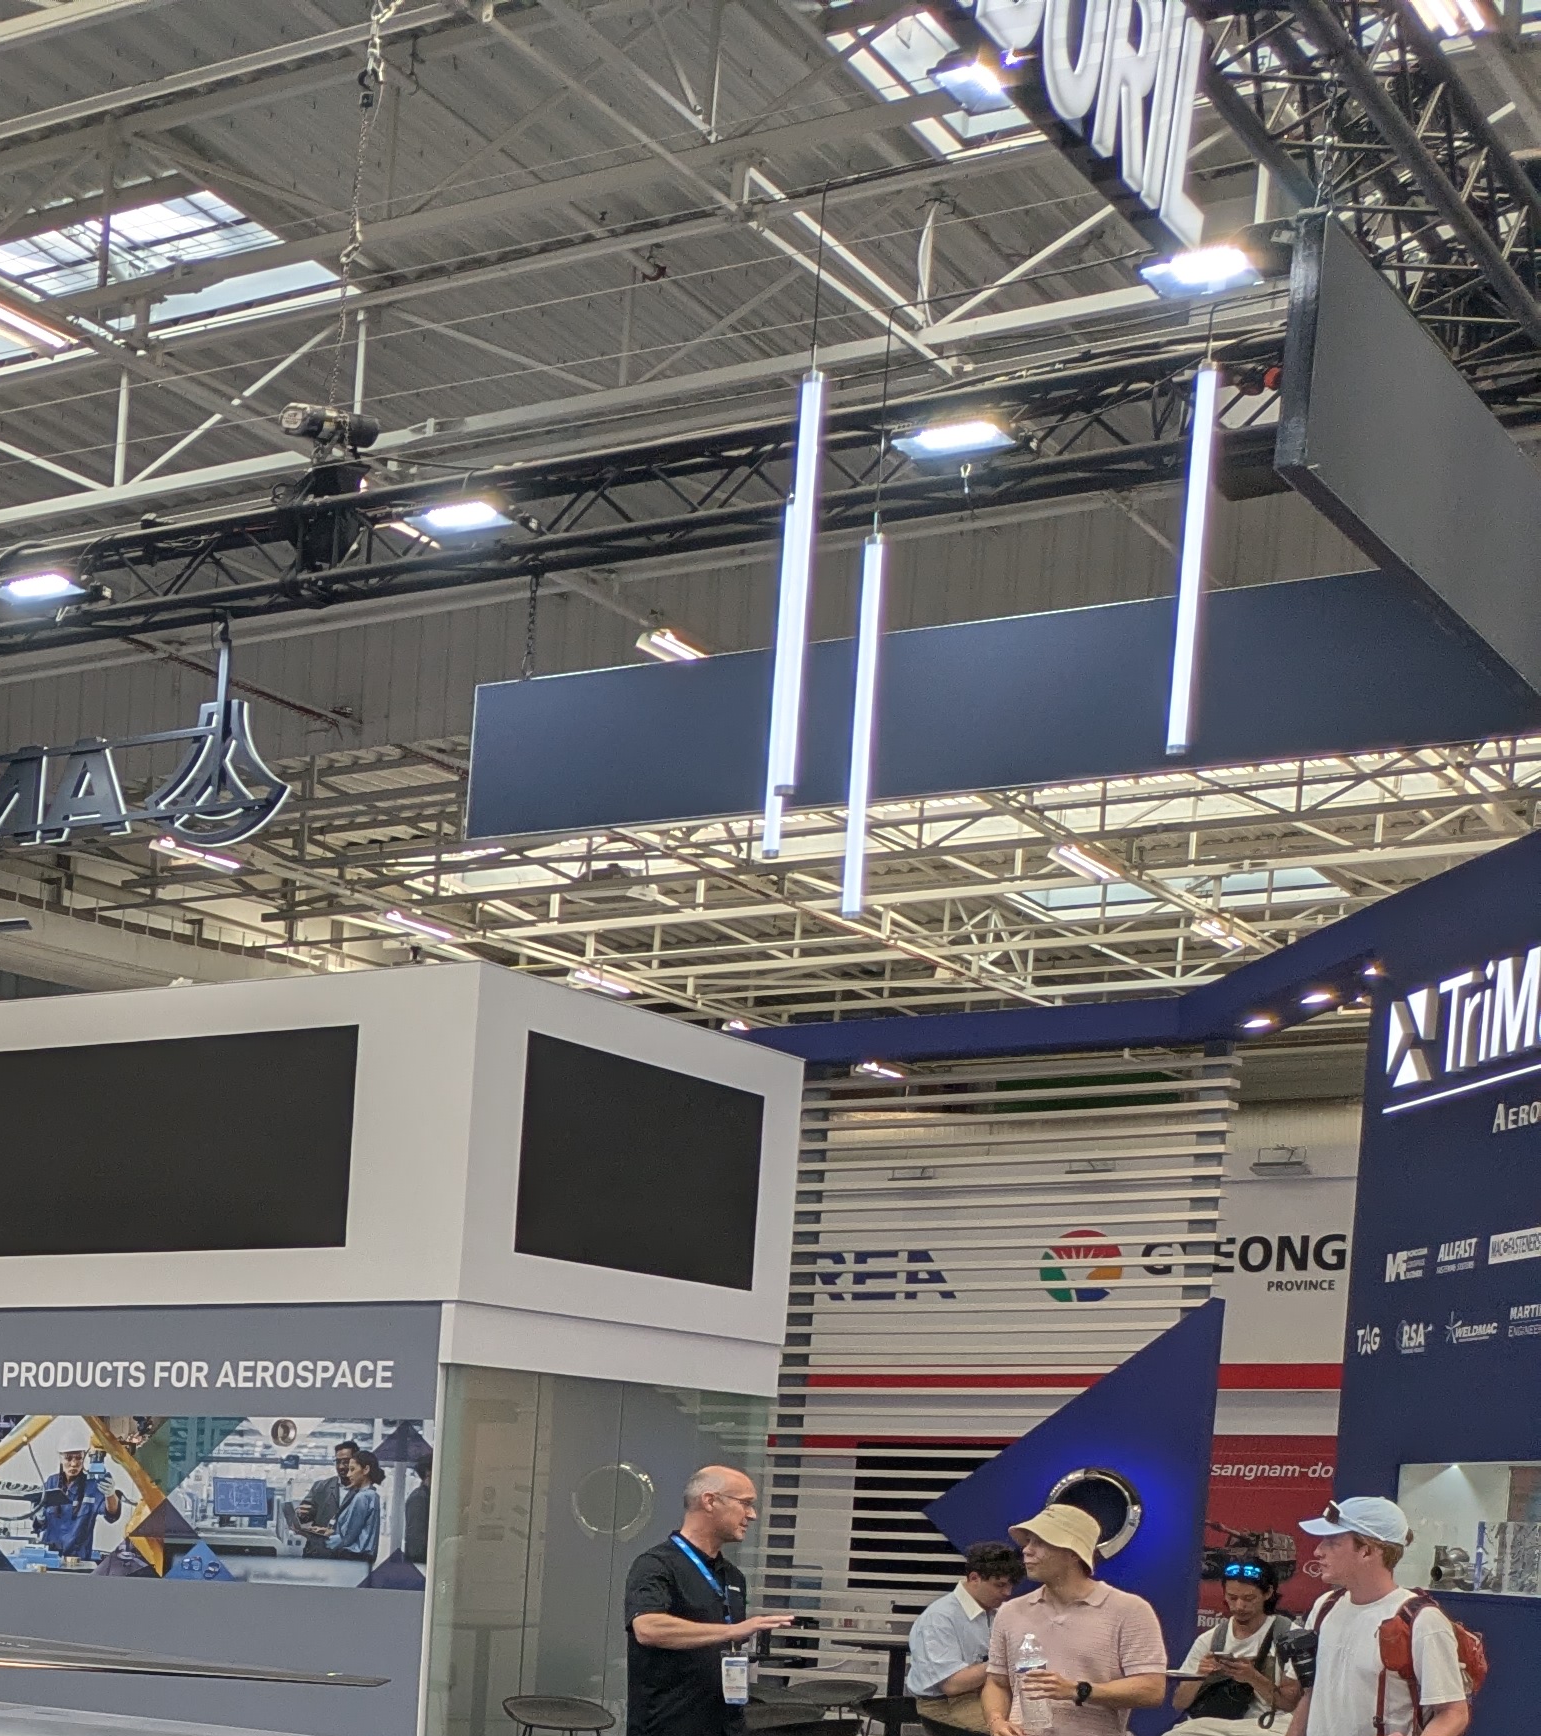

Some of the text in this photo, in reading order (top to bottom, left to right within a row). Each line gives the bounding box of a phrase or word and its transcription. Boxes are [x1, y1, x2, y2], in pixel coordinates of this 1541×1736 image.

[1439, 946, 1541, 1073] TriM
[1492, 1101, 1541, 1134] AERO
[1141, 1233, 1348, 1276] GEONG
[1437, 1237, 1478, 1262] ALLFAST
[814, 1250, 957, 1301] REA
[1267, 1279, 1335, 1292] PROVINCE
[1401, 1322, 1425, 1348] RSA
[2, 1361, 146, 1388] PRODUCTS
[153, 1361, 209, 1388] FOR
[215, 1360, 395, 1389] AEROSPACE
[1210, 1462, 1334, 1480] sangnam-do
